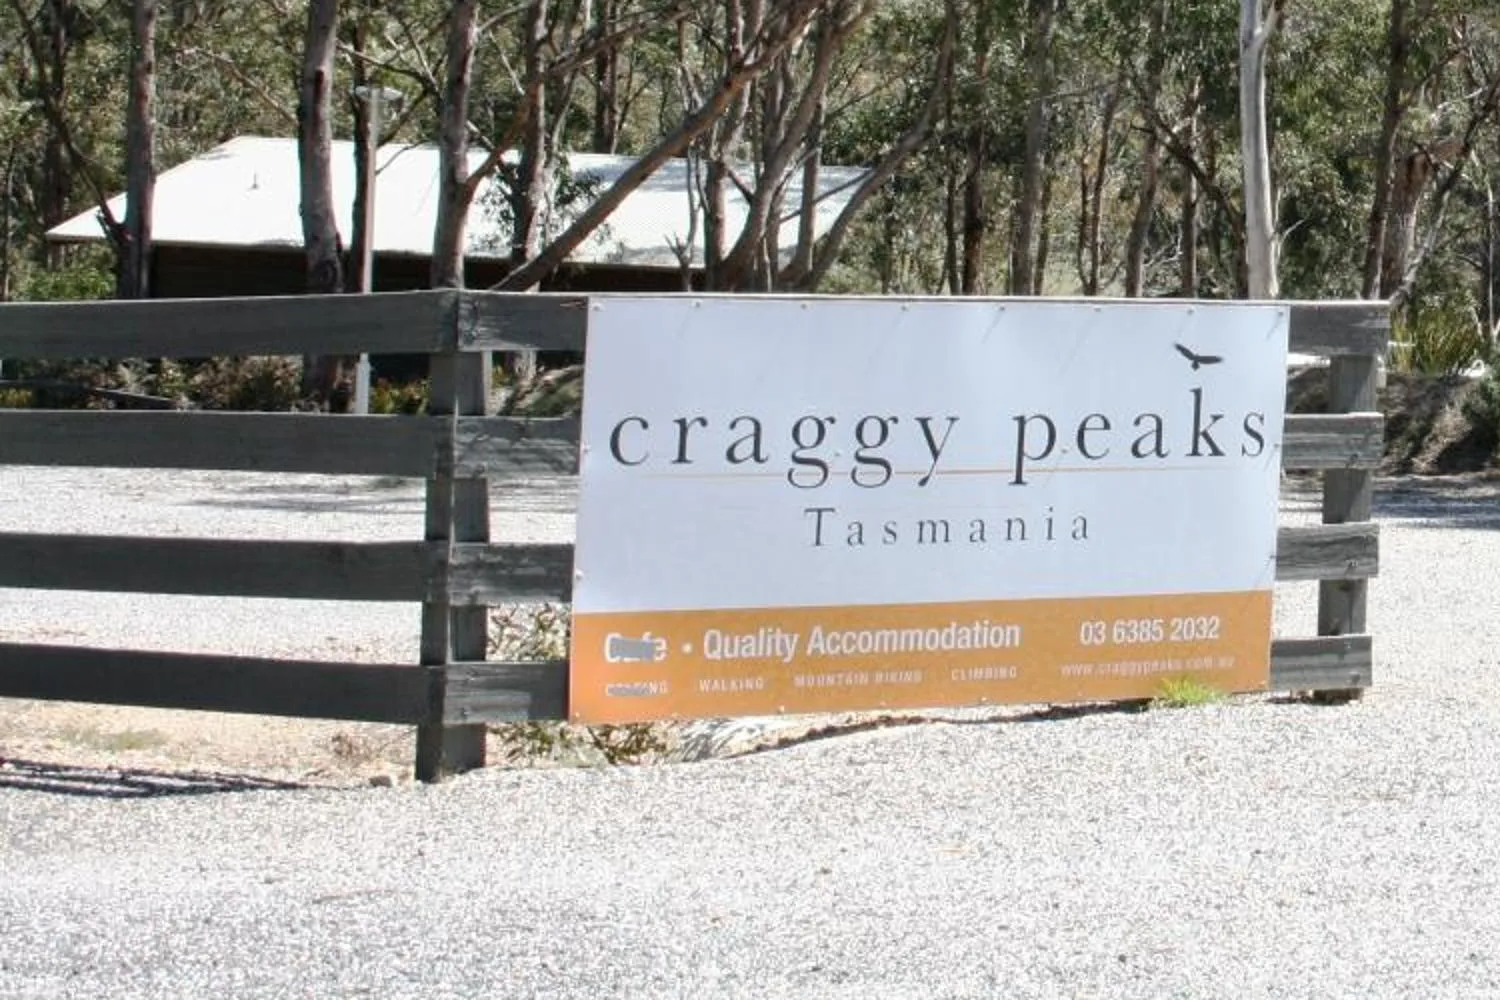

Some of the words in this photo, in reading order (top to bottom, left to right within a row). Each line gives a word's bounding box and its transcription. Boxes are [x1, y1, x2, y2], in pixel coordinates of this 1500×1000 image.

[608, 414, 960, 489] craggy
[1008, 386, 1266, 486] peaks
[803, 506, 1089, 547] Tasmania
[703, 626, 801, 663] Quality
[805, 619, 1021, 657] Accommodation
[1079, 620, 1106, 646] 03
[1111, 618, 1165, 644] 6385
[1169, 615, 1221, 642] 2032
[698, 677, 765, 693] WALKING
[793, 670, 869, 688] MOUNTAIN
[951, 665, 1018, 682] CLIMBING
